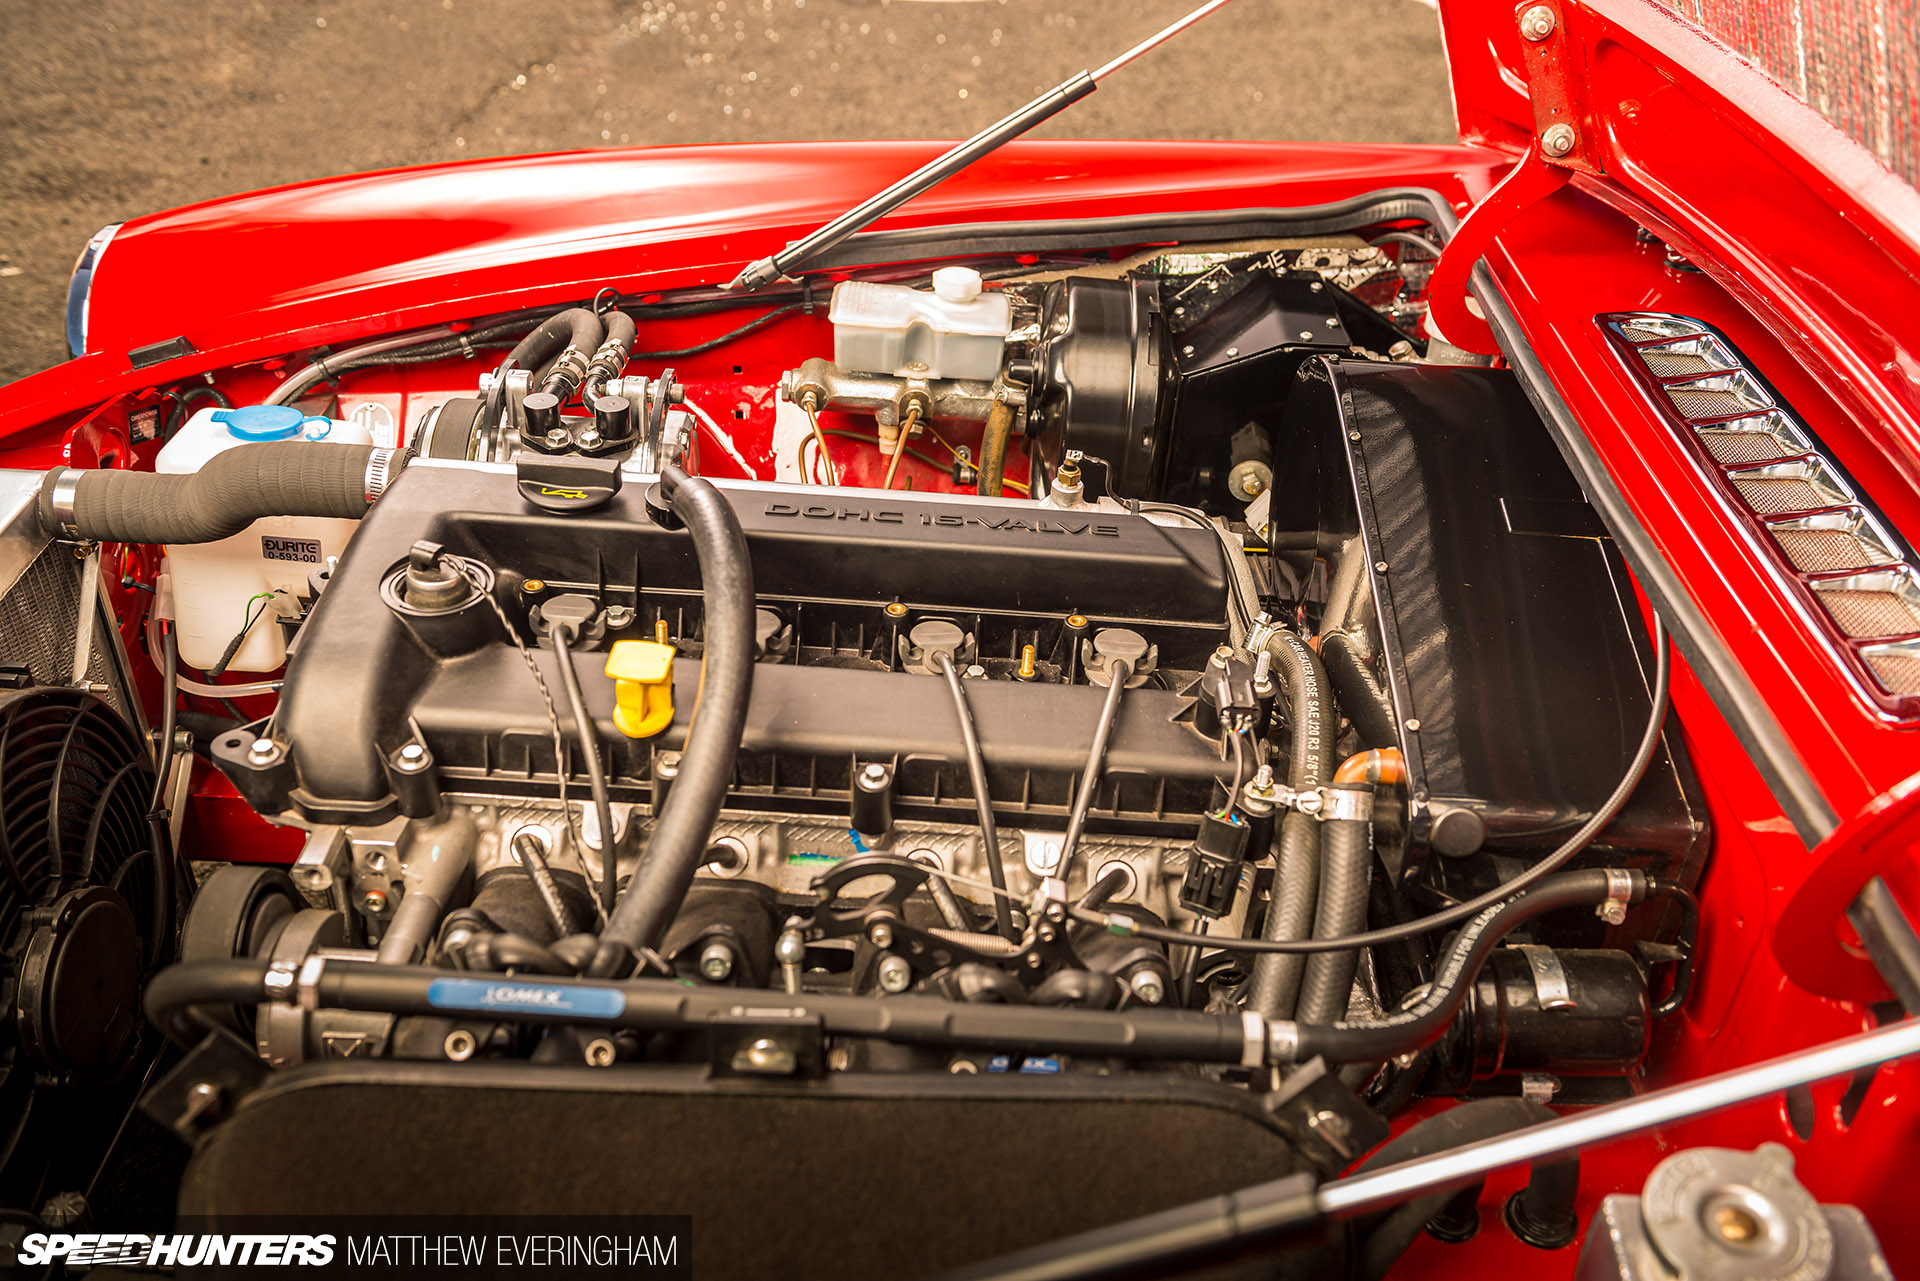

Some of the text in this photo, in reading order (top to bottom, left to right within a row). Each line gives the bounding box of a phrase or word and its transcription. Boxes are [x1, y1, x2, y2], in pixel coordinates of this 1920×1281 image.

[764, 501, 1120, 537] DOHC 16-VALVE
[264, 540, 317, 553] DURITE
[268, 551, 316, 563] 0-593-00
[1306, 676, 1318, 697] HOSE
[1308, 700, 1320, 718] SAE
[1308, 720, 1320, 735] J20
[1307, 737, 1320, 750] R3
